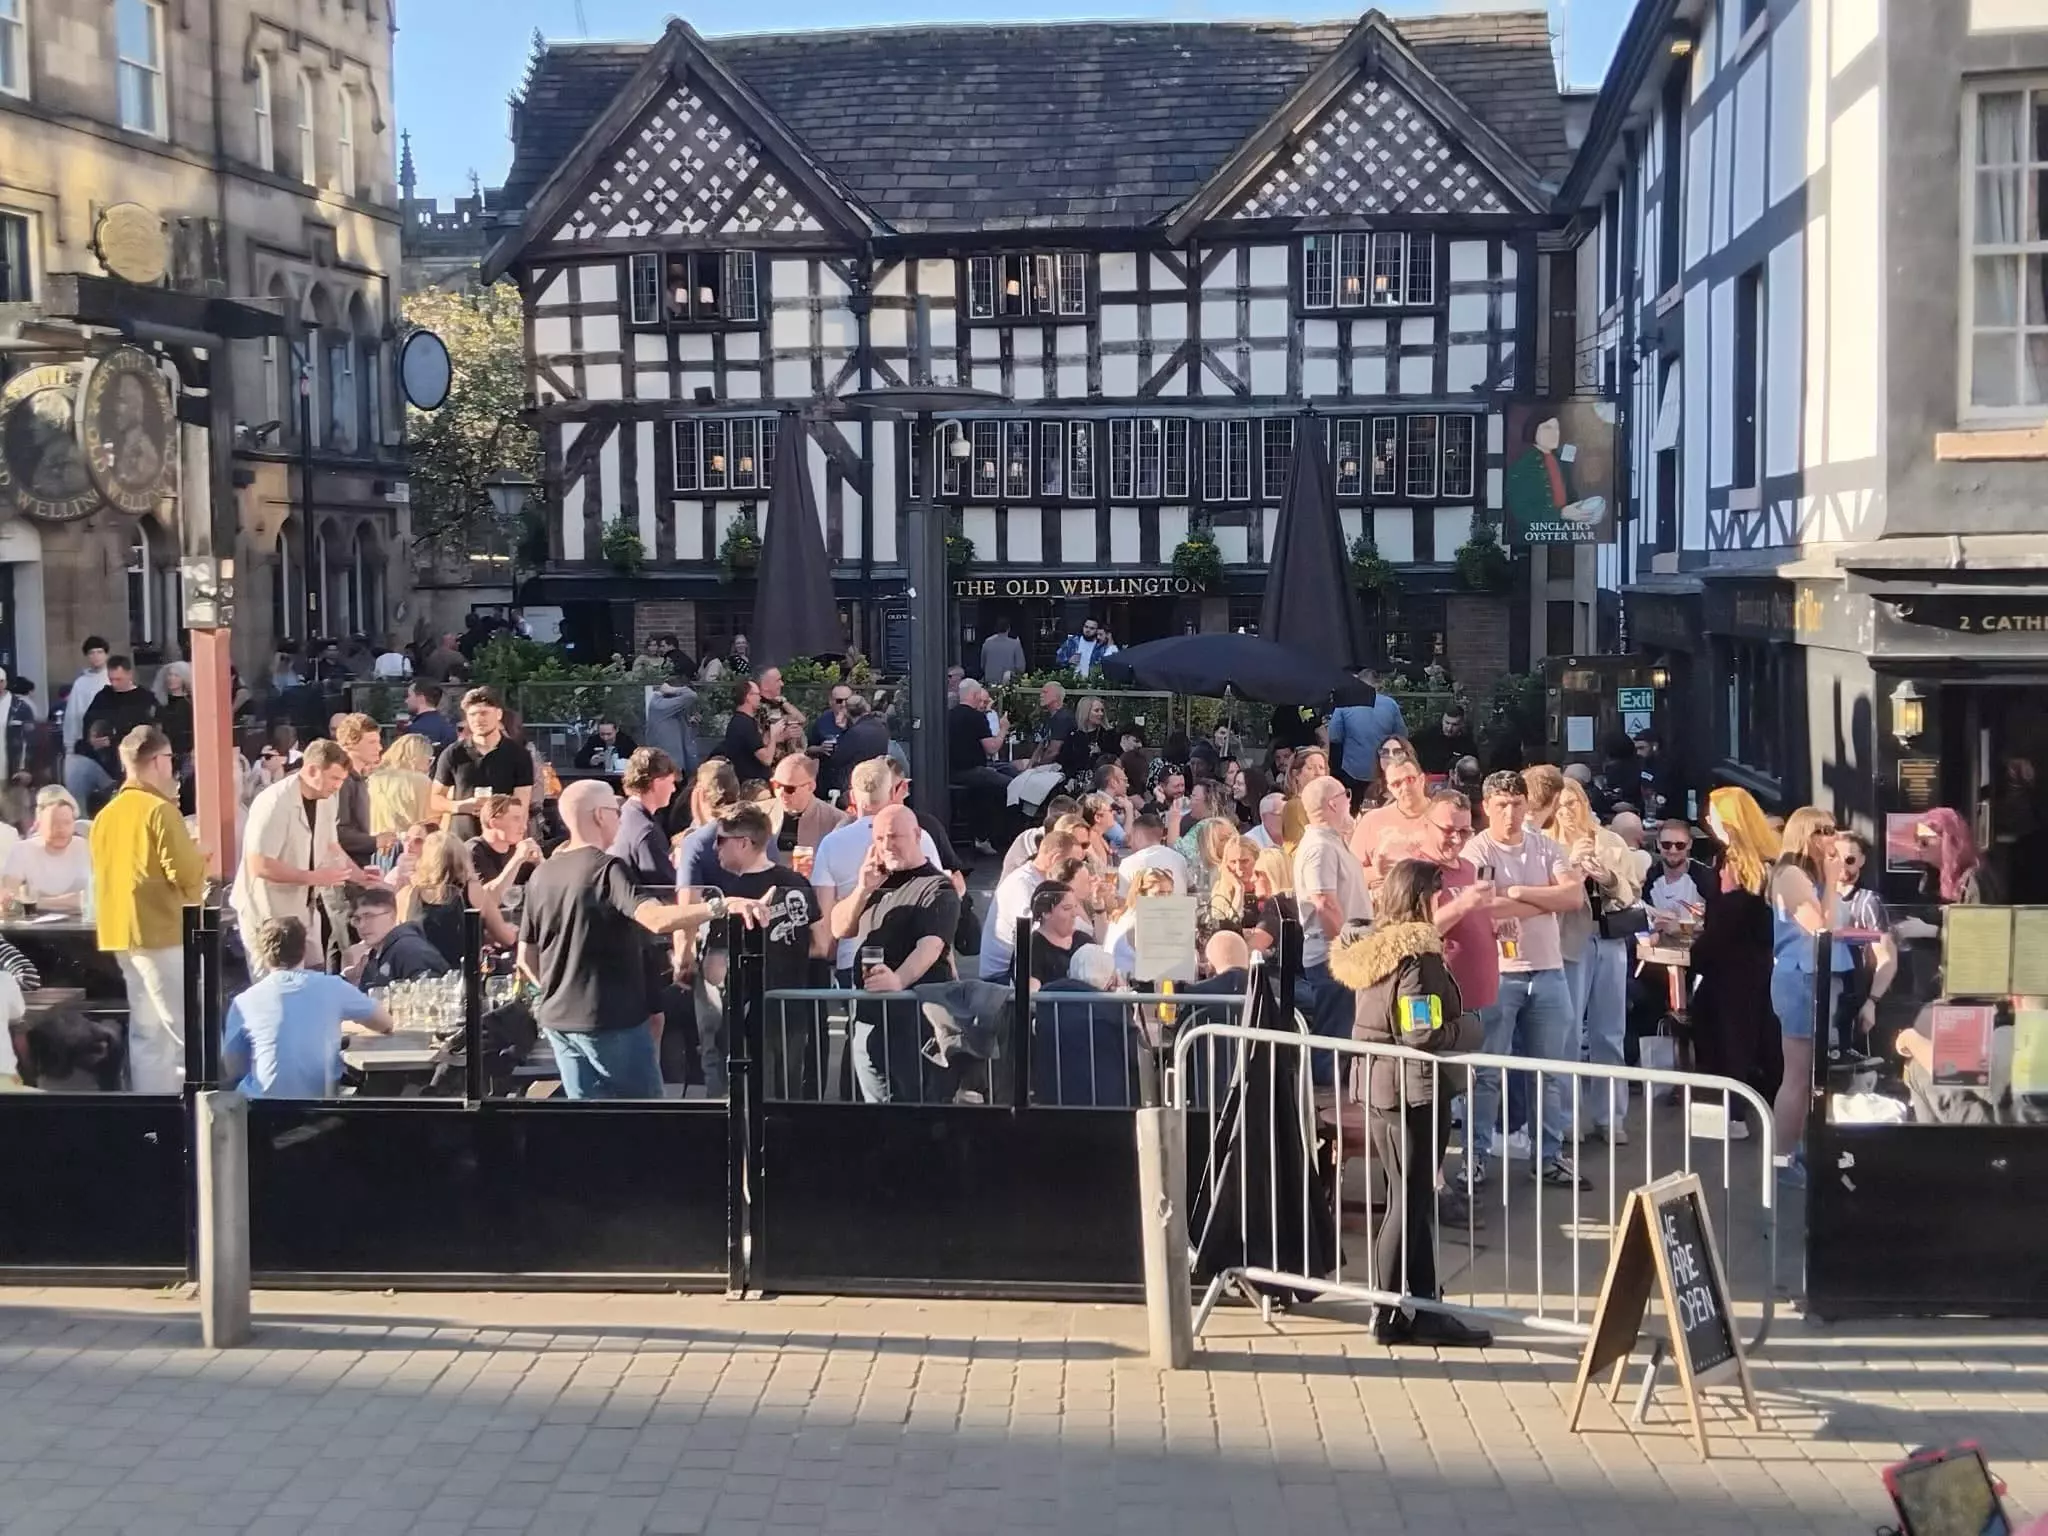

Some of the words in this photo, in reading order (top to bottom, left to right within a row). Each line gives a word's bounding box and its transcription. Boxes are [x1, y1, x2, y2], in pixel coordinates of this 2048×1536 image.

[17, 488, 101, 518] WELLIN
[1524, 532, 1568, 541] OYSTER
[1572, 532, 1596, 540] BAR
[953, 580, 995, 596] THE
[1006, 579, 1050, 595] OLD
[1060, 577, 1207, 595] WELLINGTON
[1959, 616, 1971, 630] 2
[1620, 691, 1653, 708] Exit
[1672, 1244, 1699, 1287] ARE
[1677, 1285, 1716, 1333] OPEN
